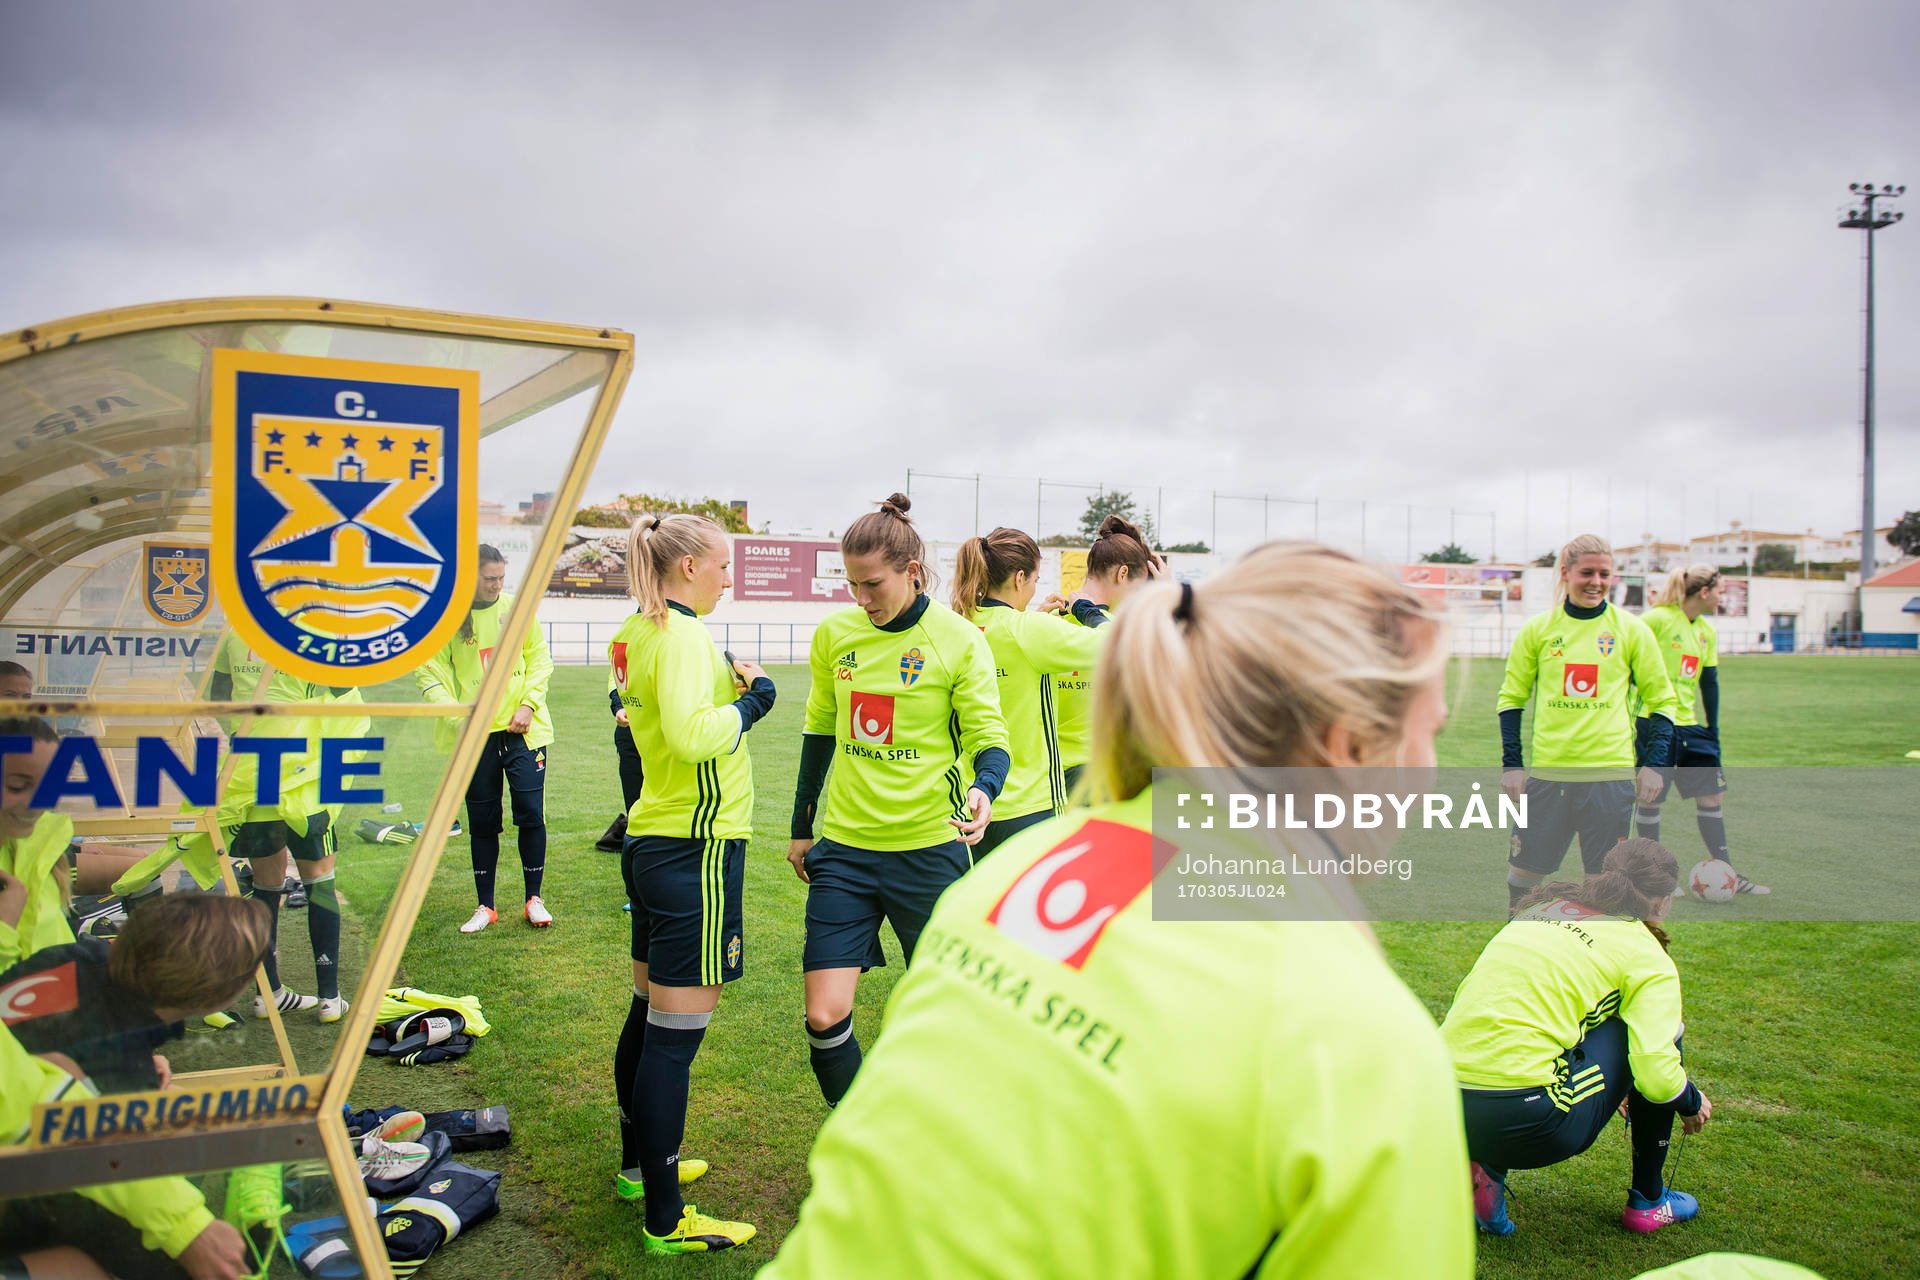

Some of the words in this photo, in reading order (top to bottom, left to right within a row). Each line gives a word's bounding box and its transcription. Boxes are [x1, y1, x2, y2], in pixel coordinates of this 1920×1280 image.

[334, 390, 378, 419] C.
[263, 451, 292, 474] F.
[409, 459, 436, 482] F.
[745, 546, 791, 557] SOARES
[297, 631, 409, 665] 1-12-83
[837, 667, 853, 682] ICA
[839, 660, 858, 669] adidas
[888, 749, 920, 761] SPEL
[1563, 922, 1594, 948] SPEL
[1033, 993, 1125, 1074] SPEL
[38, 1083, 310, 1145] FABRIGIMNO
